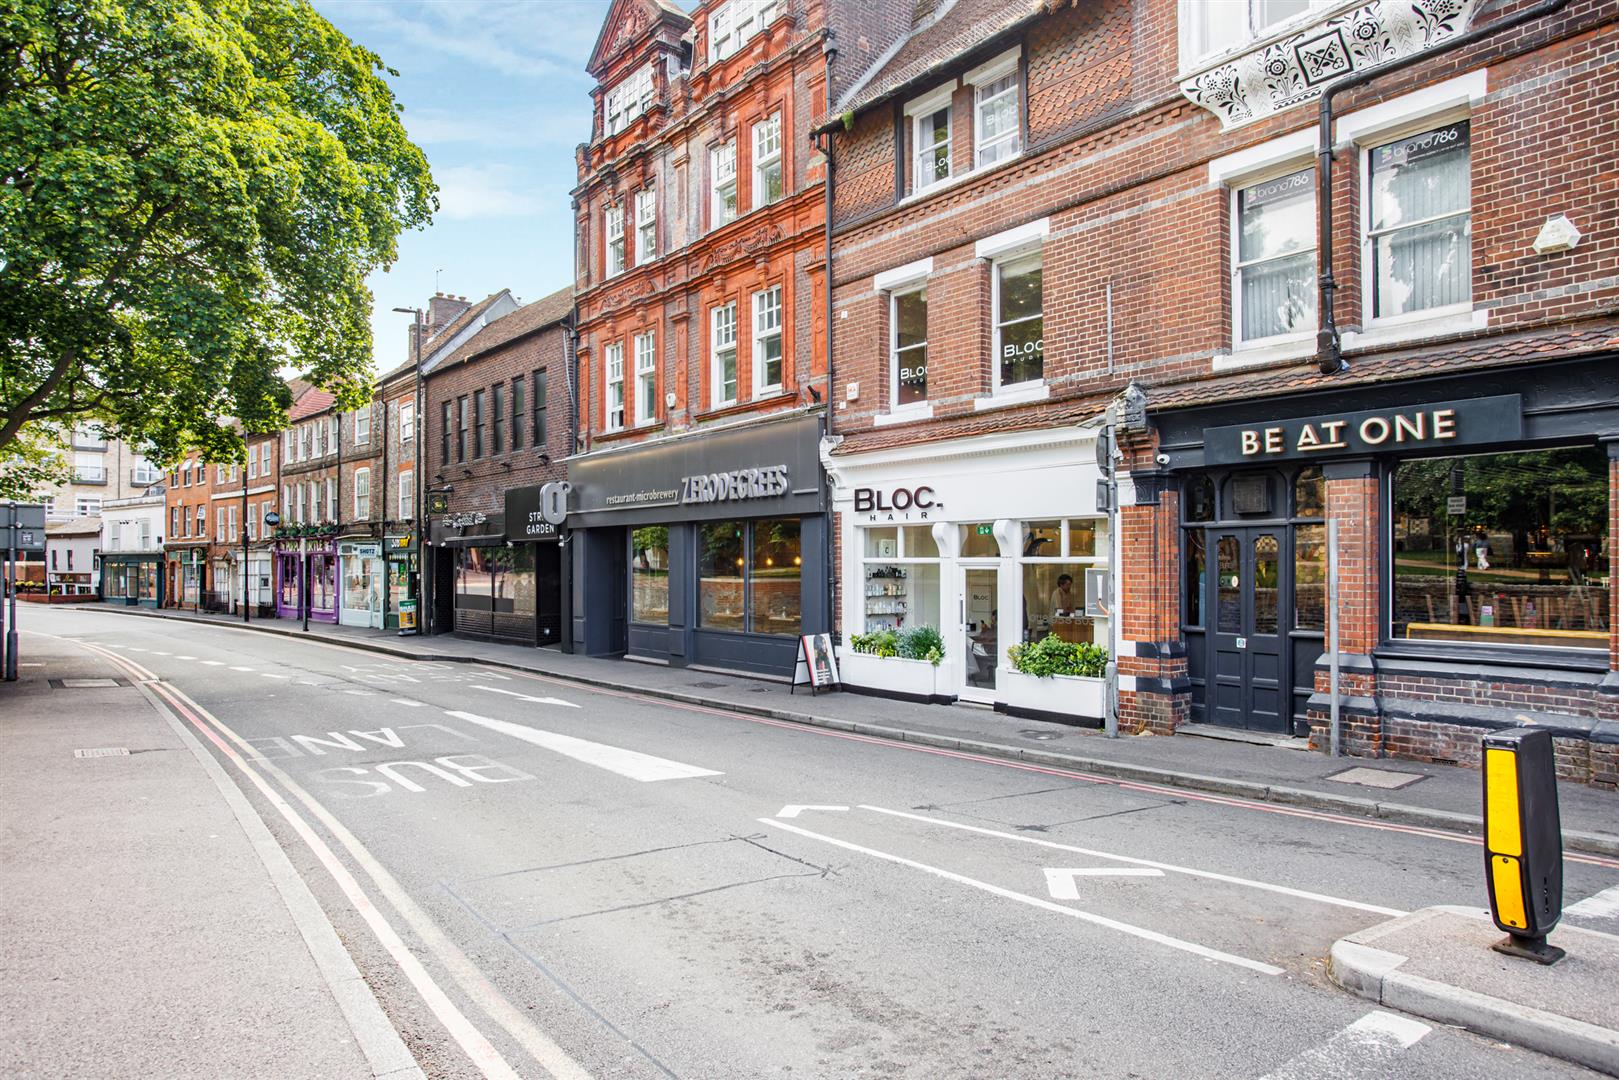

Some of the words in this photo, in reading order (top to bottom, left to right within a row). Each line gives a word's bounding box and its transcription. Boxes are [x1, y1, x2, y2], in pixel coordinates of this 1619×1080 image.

[1392, 127, 1459, 158] brand786
[1257, 173, 1310, 198] brand786
[1241, 427, 1285, 456] BE
[1297, 420, 1348, 451] AT
[1359, 408, 1457, 446] ONE
[681, 464, 788, 505] ZERODEGREES
[854, 486, 944, 512] BLOC.
[526, 524, 555, 535] GARDEN
[248, 724, 480, 762] LANE
[312, 754, 538, 799] BUS
